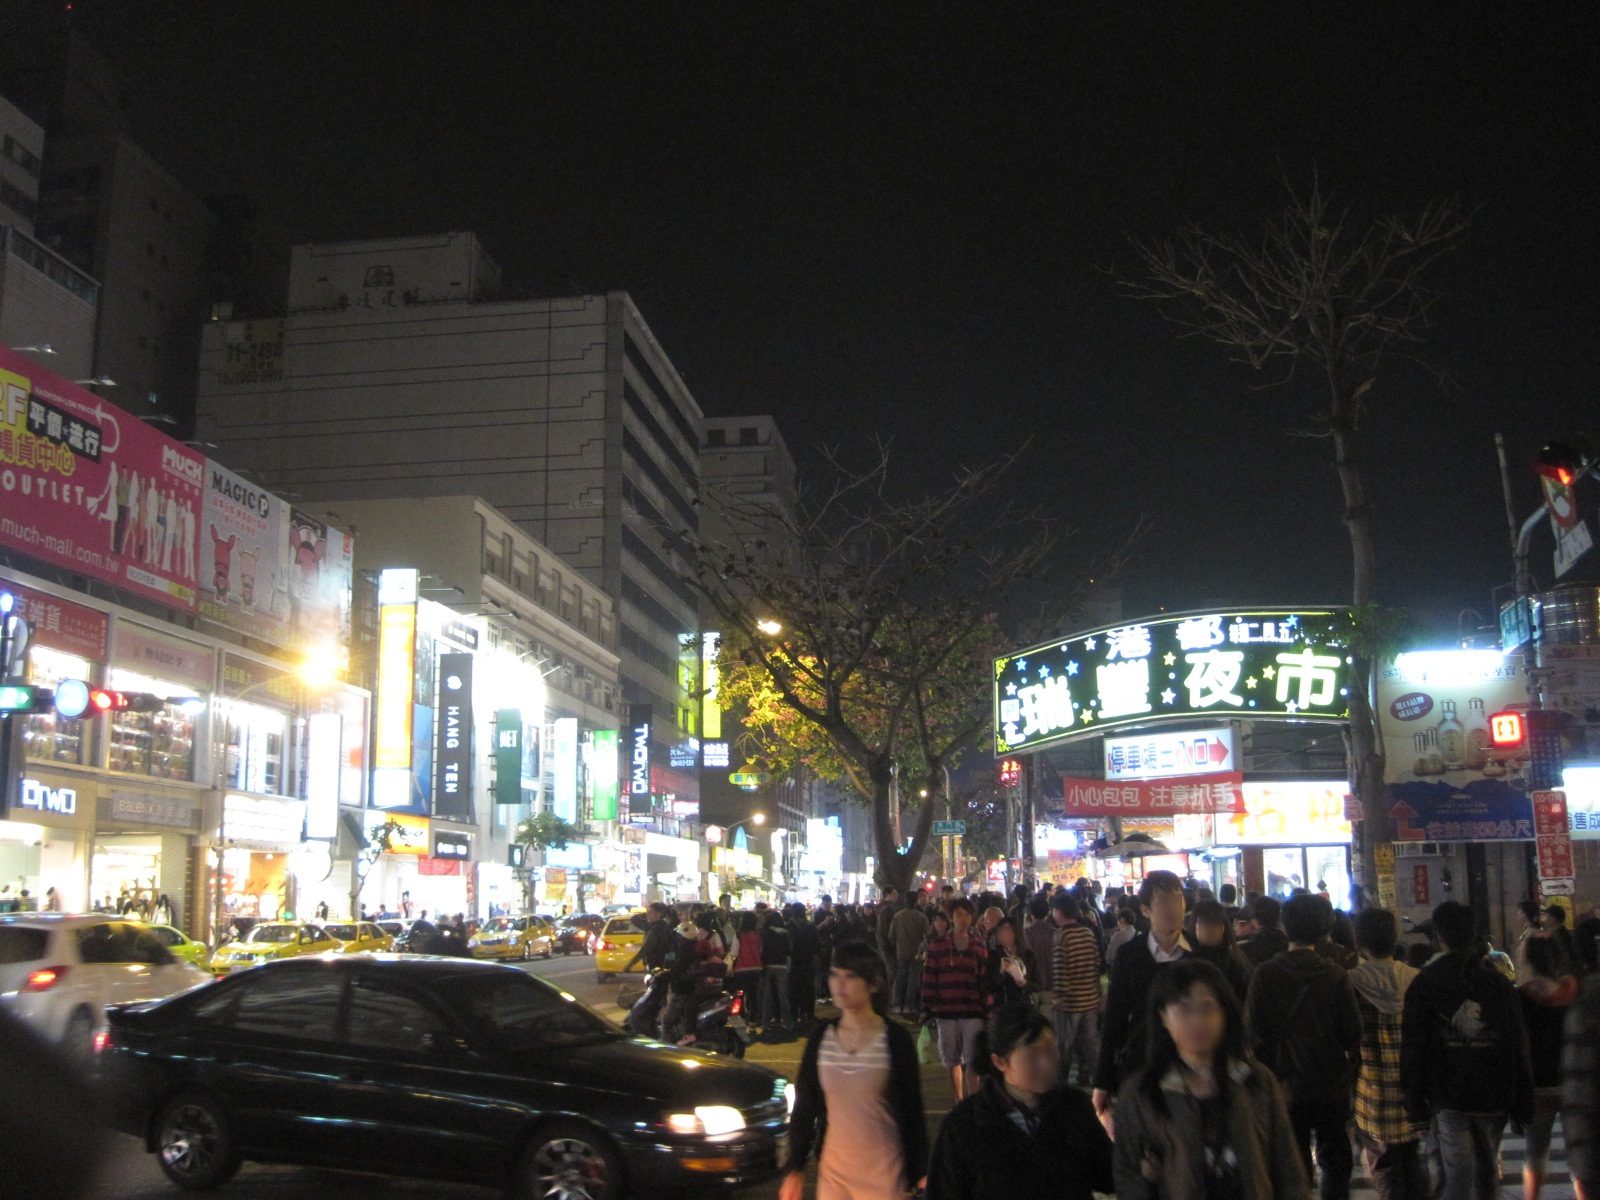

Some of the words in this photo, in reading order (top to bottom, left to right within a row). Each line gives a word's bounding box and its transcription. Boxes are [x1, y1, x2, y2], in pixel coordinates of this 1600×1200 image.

[162, 445, 203, 482] MUCH
[3, 472, 85, 506] OUTLET
[212, 471, 257, 510] MAGIC
[446, 706, 460, 749] HANG
[499, 729, 518, 748] NET
[445, 763, 459, 793] TEN
[1068, 785, 1142, 808] 小心包包
